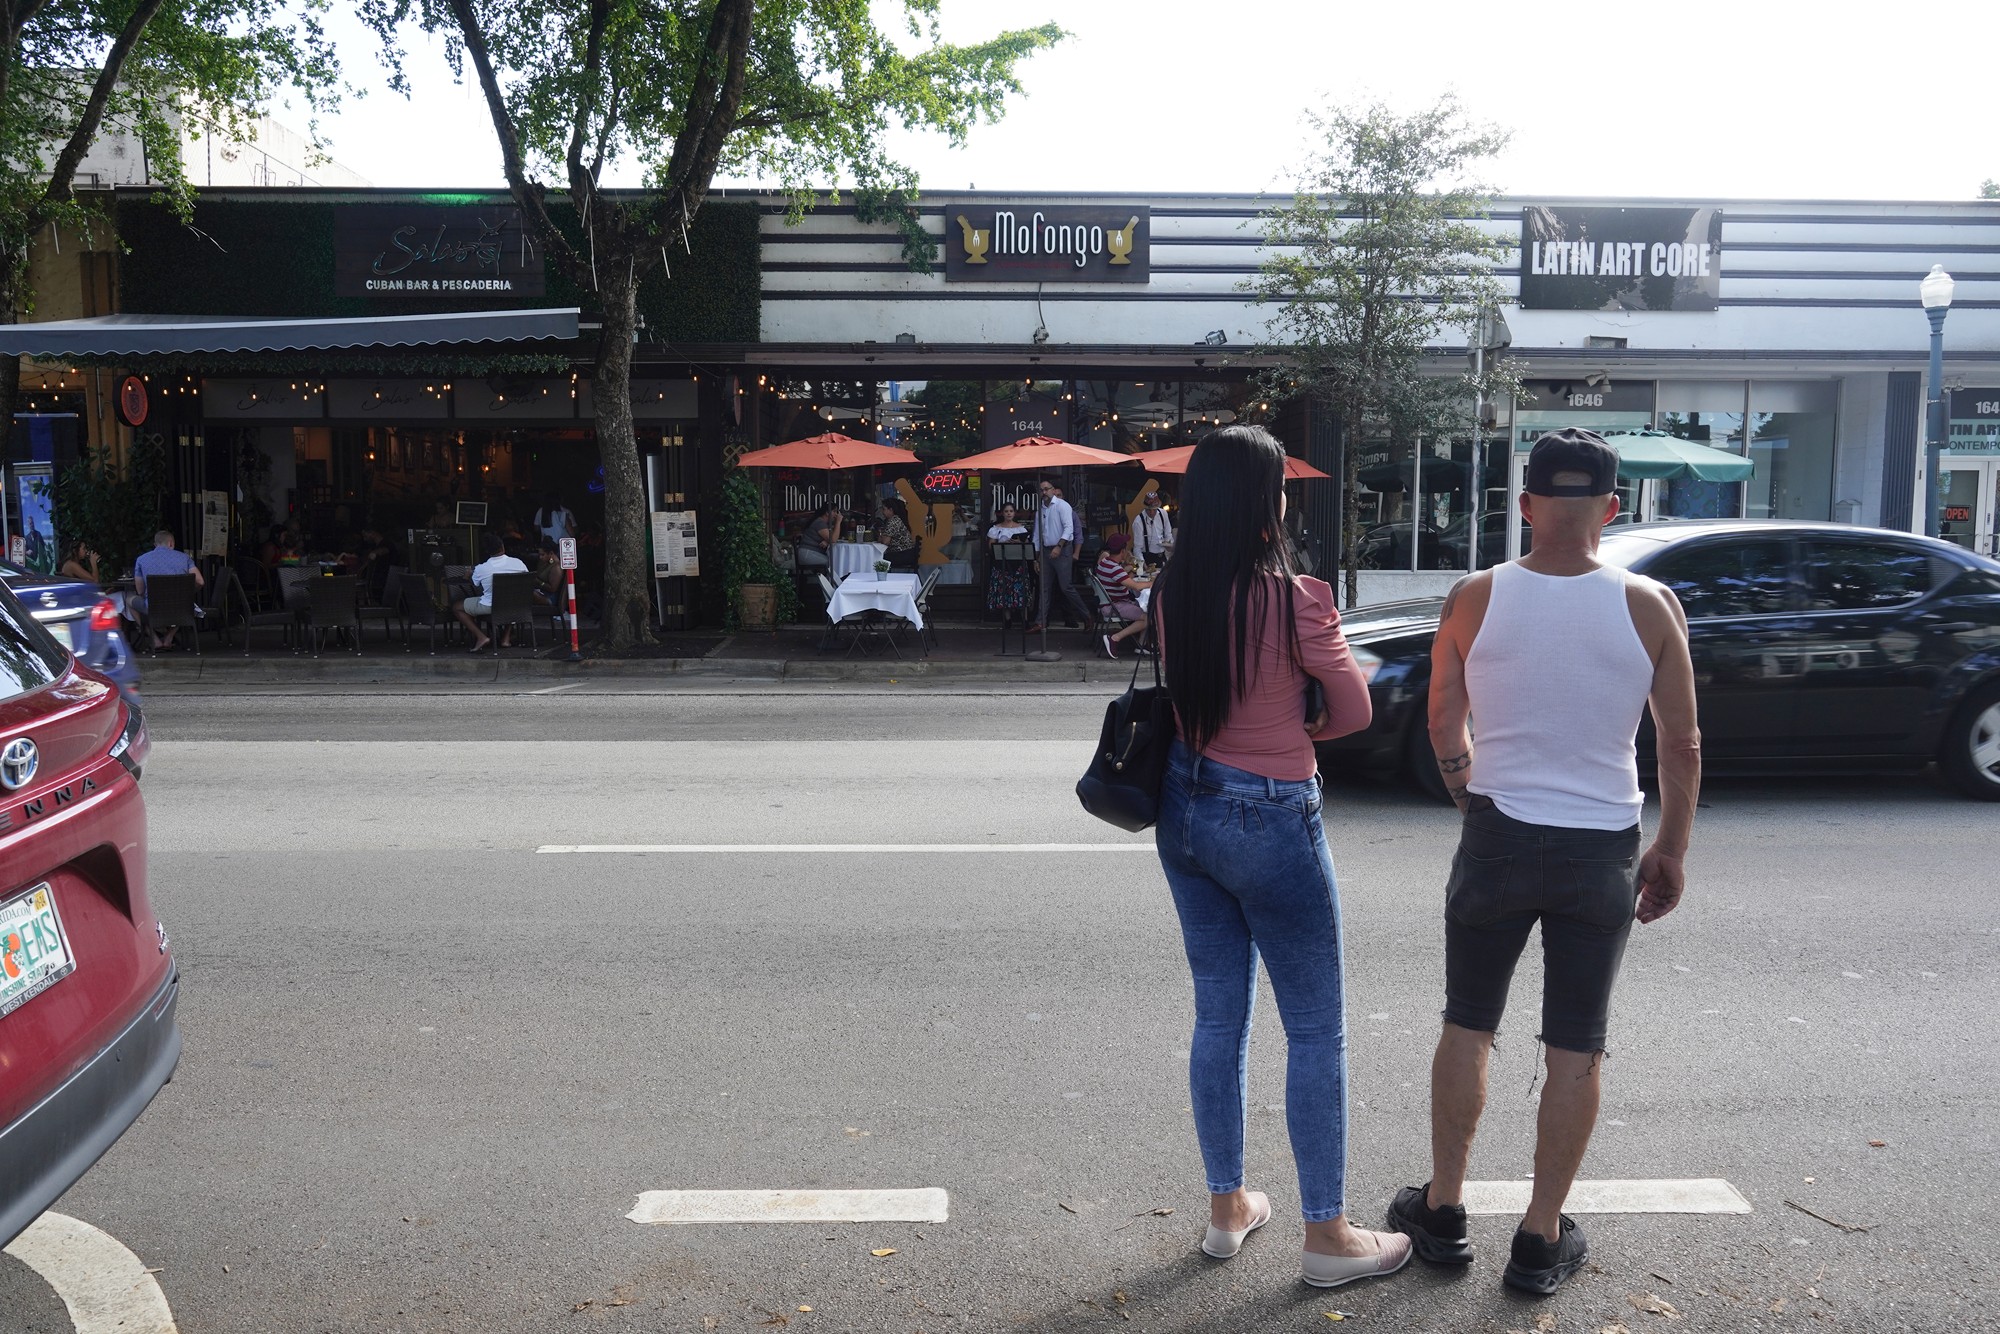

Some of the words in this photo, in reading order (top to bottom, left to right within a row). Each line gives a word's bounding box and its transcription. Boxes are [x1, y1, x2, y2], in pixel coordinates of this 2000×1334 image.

[994, 211, 1103, 268] Mofongo
[1532, 241, 1596, 275] LATIN
[1600, 242, 1647, 276] ART
[1651, 242, 1711, 277] CORE
[365, 279, 402, 290] CUBAN
[406, 279, 429, 290] BAR
[432, 279, 440, 290] &
[442, 279, 511, 290] PESCADERIA
[1567, 393, 1603, 407] 1646
[1012, 420, 1043, 431] 1644
[1950, 424, 1973, 436] TIN
[1949, 441, 2000, 450] ONTEMP
[924, 475, 963, 489] OPEN
[1946, 508, 1969, 520] OPEN
[19, 910, 59, 965] EMS
[1, 995, 23, 1015] WEST
[23, 974, 59, 1000] KENDALL
